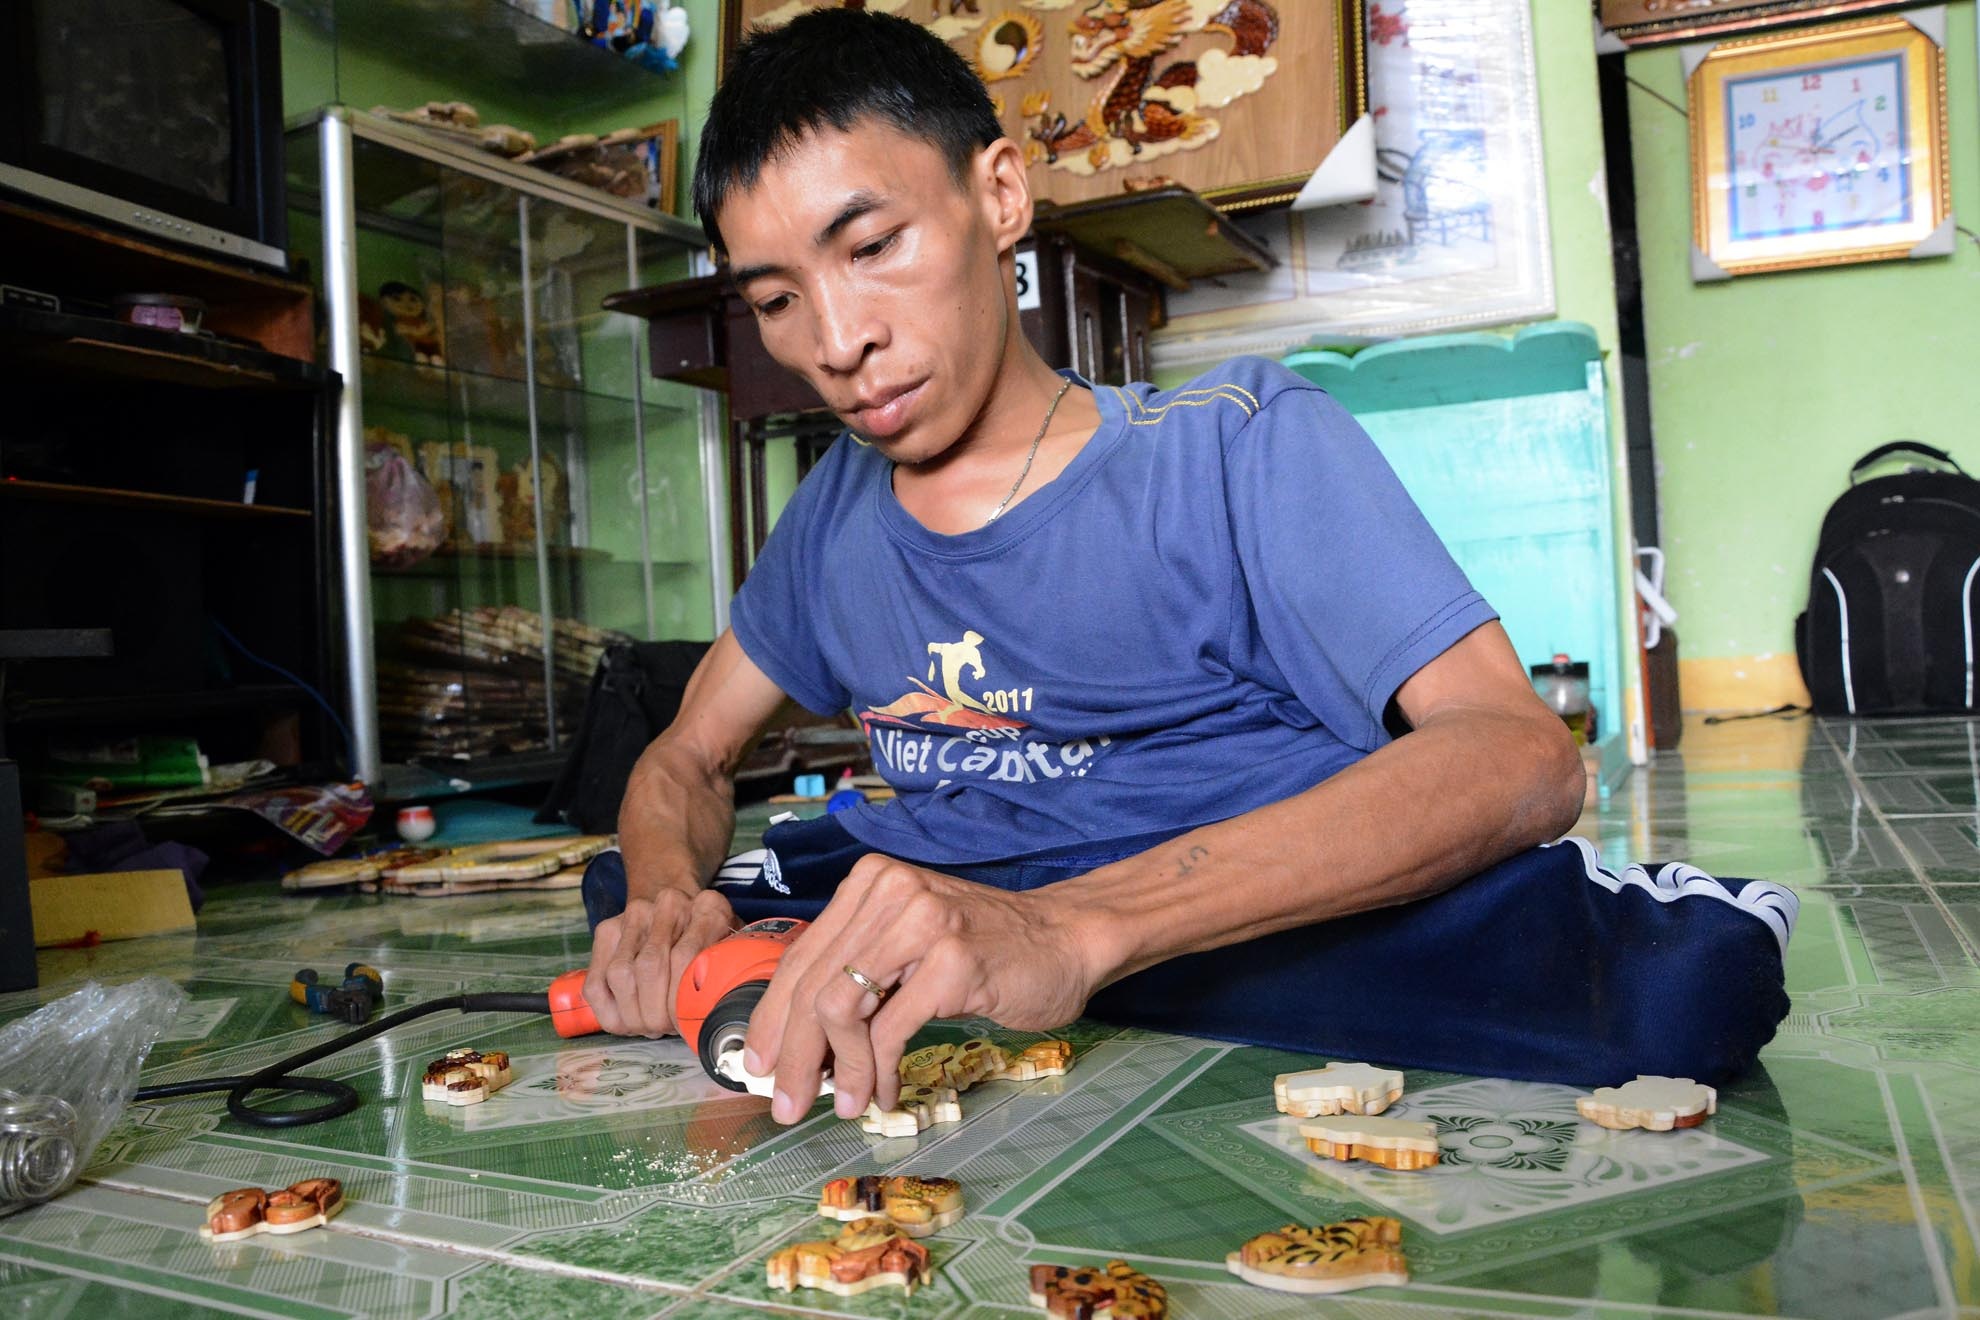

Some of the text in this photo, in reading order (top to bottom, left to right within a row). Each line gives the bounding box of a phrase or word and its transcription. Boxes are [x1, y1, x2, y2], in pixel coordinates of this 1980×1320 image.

[1801, 74, 1822, 92] 12
[1852, 77, 1861, 92] 1
[1762, 87, 1778, 103] 11
[1875, 96, 1887, 111] 2
[1738, 113, 1756, 129] 10
[1877, 167, 1889, 183] 4
[982, 687, 1033, 713] 2011
[875, 729, 933, 773] Viet
